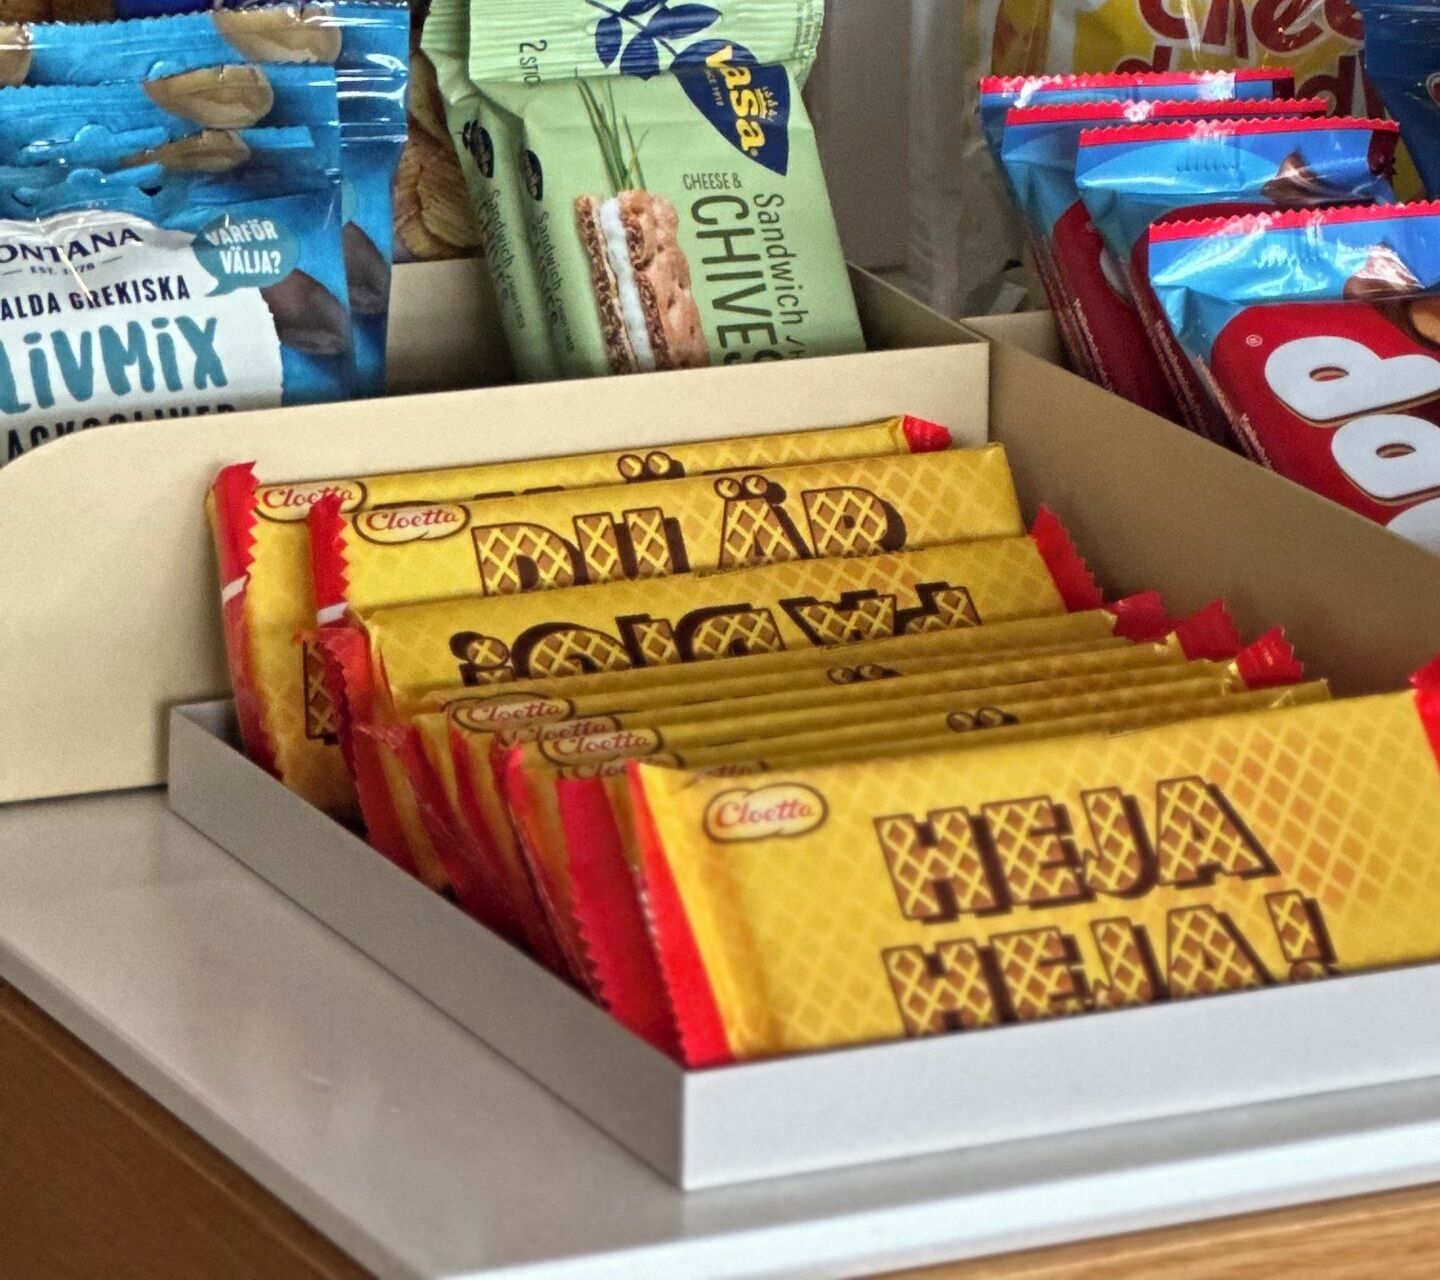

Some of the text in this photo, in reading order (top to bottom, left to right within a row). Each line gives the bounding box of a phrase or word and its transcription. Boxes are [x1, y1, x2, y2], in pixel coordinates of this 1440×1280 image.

[518, 39, 549, 55] 2
[682, 172, 743, 192] CHEESE &
[0, 227, 144, 264] ONTANA
[205, 217, 279, 247] VARFÖR
[219, 245, 283, 275] VÄLJA?
[752, 192, 809, 327] Sandwich
[0, 274, 192, 322] ALDA GREKISKA
[261, 485, 355, 512] Cloetta
[366, 507, 458, 534] Cloetta
[466, 699, 564, 723] Cloetta
[552, 730, 651, 756] Cloetta
[714, 800, 815, 832] Cloetta
[873, 775, 1280, 923] HEJA
[880, 890, 1342, 1038] HEJA!
